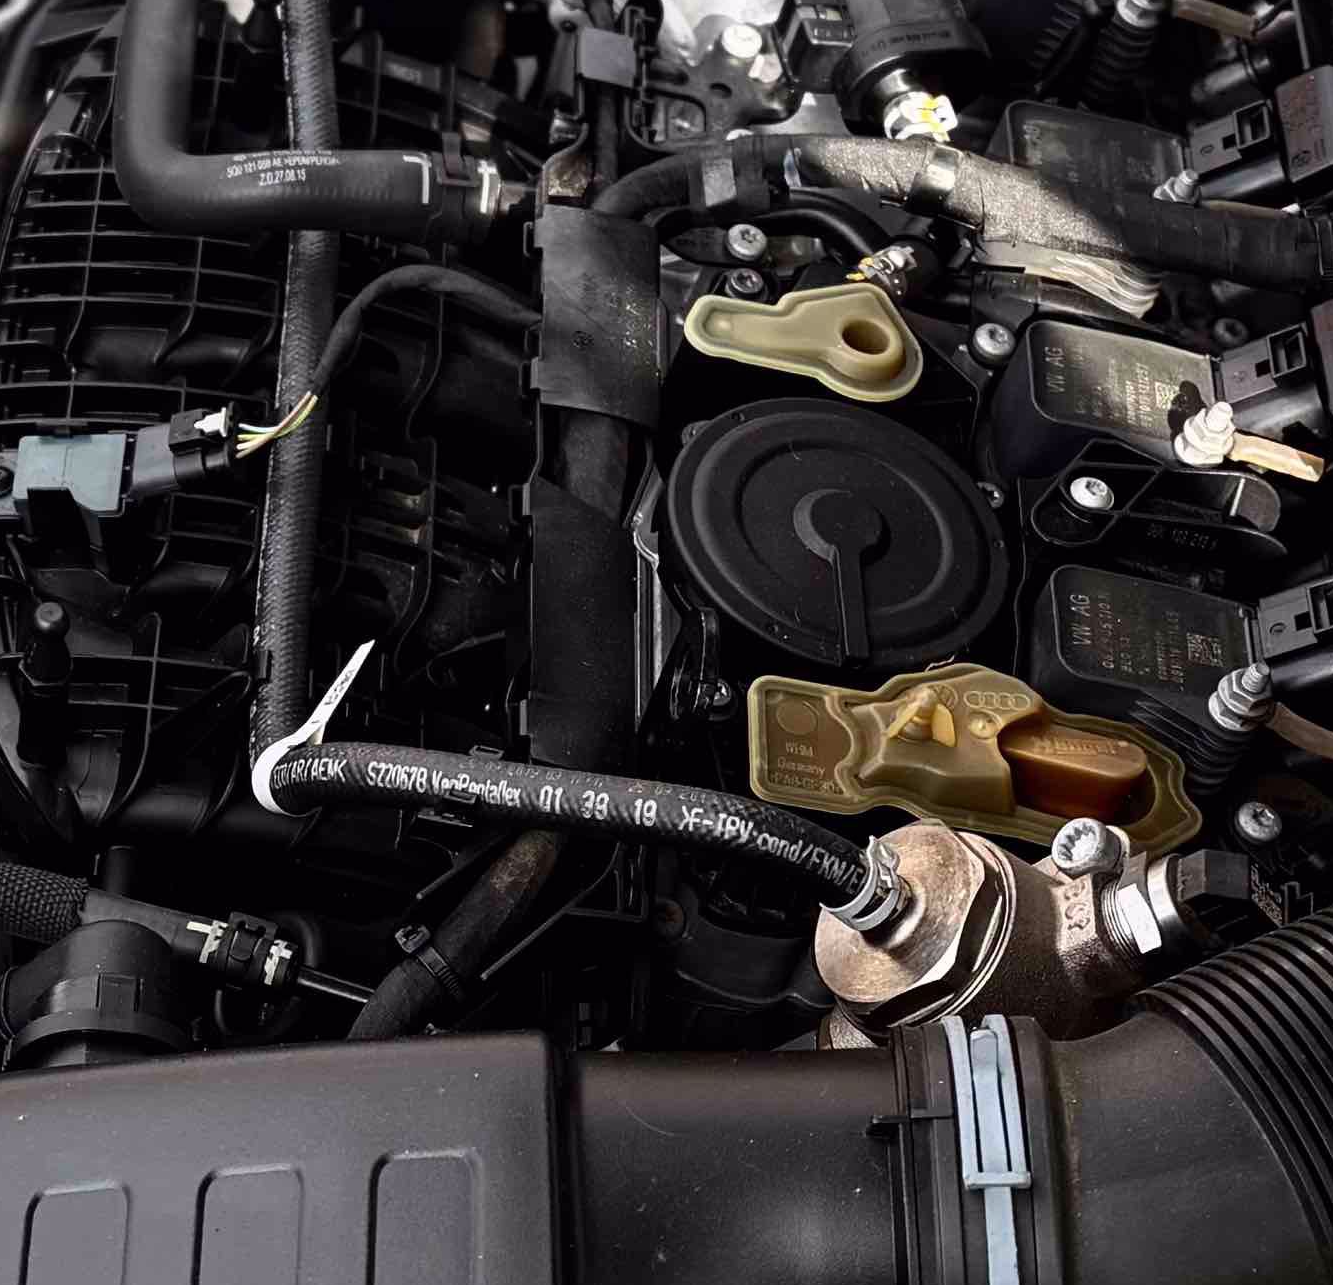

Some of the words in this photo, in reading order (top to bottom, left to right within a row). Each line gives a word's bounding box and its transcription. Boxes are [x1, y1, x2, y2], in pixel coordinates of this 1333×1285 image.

[1044, 347, 1064, 367] AG
[1070, 594, 1091, 616] AG
[1072, 623, 1091, 645] VW
